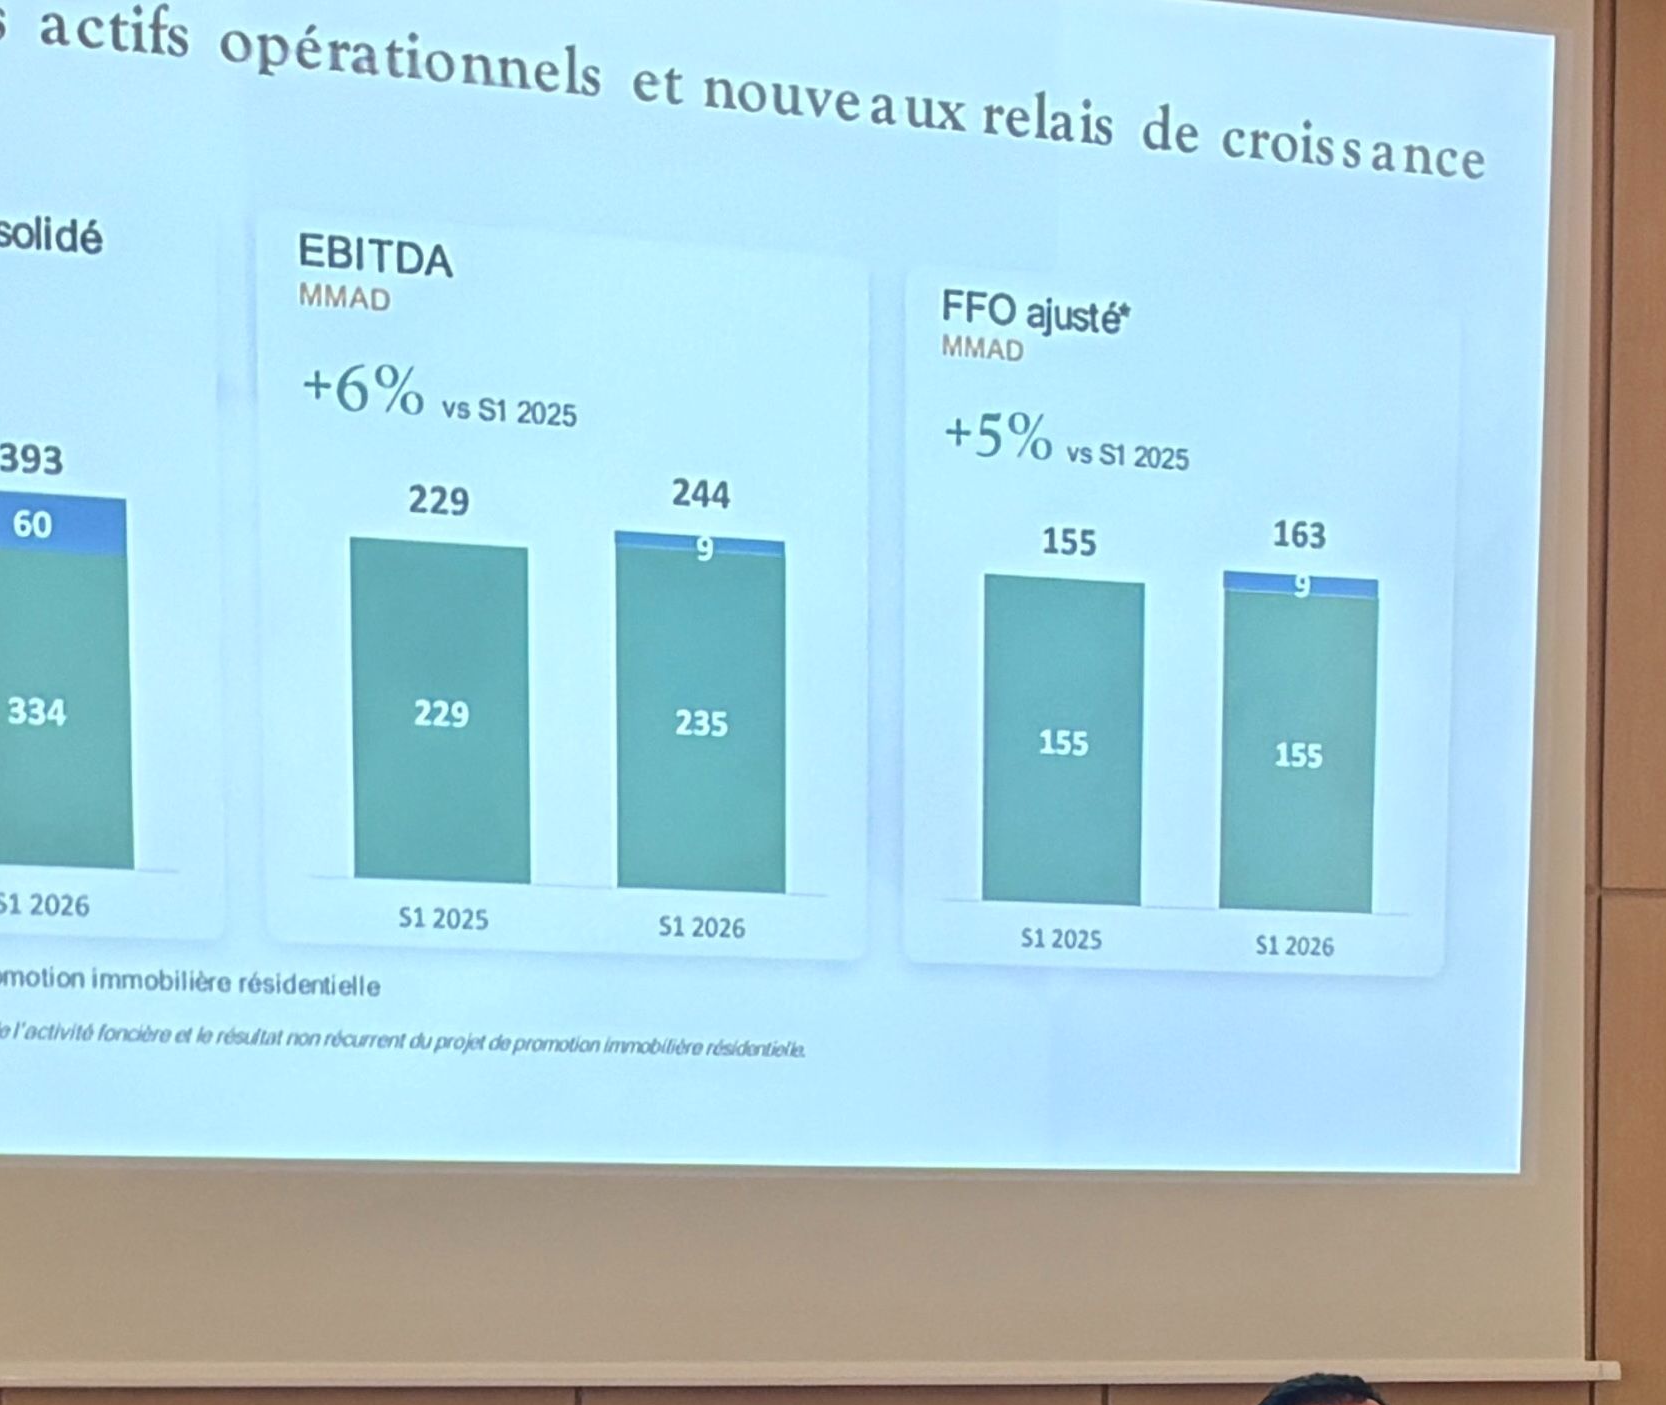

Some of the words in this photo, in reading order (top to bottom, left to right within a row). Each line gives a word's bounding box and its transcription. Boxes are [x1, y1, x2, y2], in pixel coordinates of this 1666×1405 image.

[41, 3, 188, 57] actifs
[221, 24, 600, 96] opérationnels
[634, 68, 683, 105] et
[705, 78, 965, 131] nouveaux
[984, 91, 1112, 145] relais
[1143, 104, 1198, 153] de
[1223, 120, 1484, 179] croissance
[300, 233, 453, 278] EBITDA
[300, 282, 390, 311] MMAD
[943, 289, 1016, 326] FFO
[943, 334, 1023, 361] MMAD
[304, 364, 424, 415] +6%
[442, 401, 470, 419] vs
[479, 398, 505, 421] S1
[517, 401, 577, 427] 2025
[946, 412, 1052, 460] +5%
[1067, 446, 1092, 464] vs
[1100, 443, 1124, 465] S1
[1134, 446, 1189, 471] 2025
[0, 443, 63, 475] 393
[410, 484, 469, 516] 229
[673, 478, 730, 509] 244
[14, 510, 51, 538] 60
[1275, 520, 1325, 549] 163
[695, 536, 715, 562] 9
[1044, 527, 1096, 556] 155
[1292, 574, 1313, 599] 9
[9, 697, 66, 726] 334
[415, 699, 469, 728] 229
[676, 709, 727, 737] 235
[1040, 729, 1088, 756] 155
[1276, 742, 1322, 768] 155
[30, 893, 90, 917] 2026
[399, 907, 425, 928] S1
[433, 907, 489, 930] 2025
[659, 916, 684, 937] S1
[692, 917, 745, 939] 2026
[1022, 928, 1045, 948] S1
[1052, 929, 1102, 950] 2025
[1256, 935, 1279, 955] S1
[1285, 936, 1334, 957] 2026
[92, 967, 231, 993] immobilière
[239, 972, 381, 997] résidentielle
